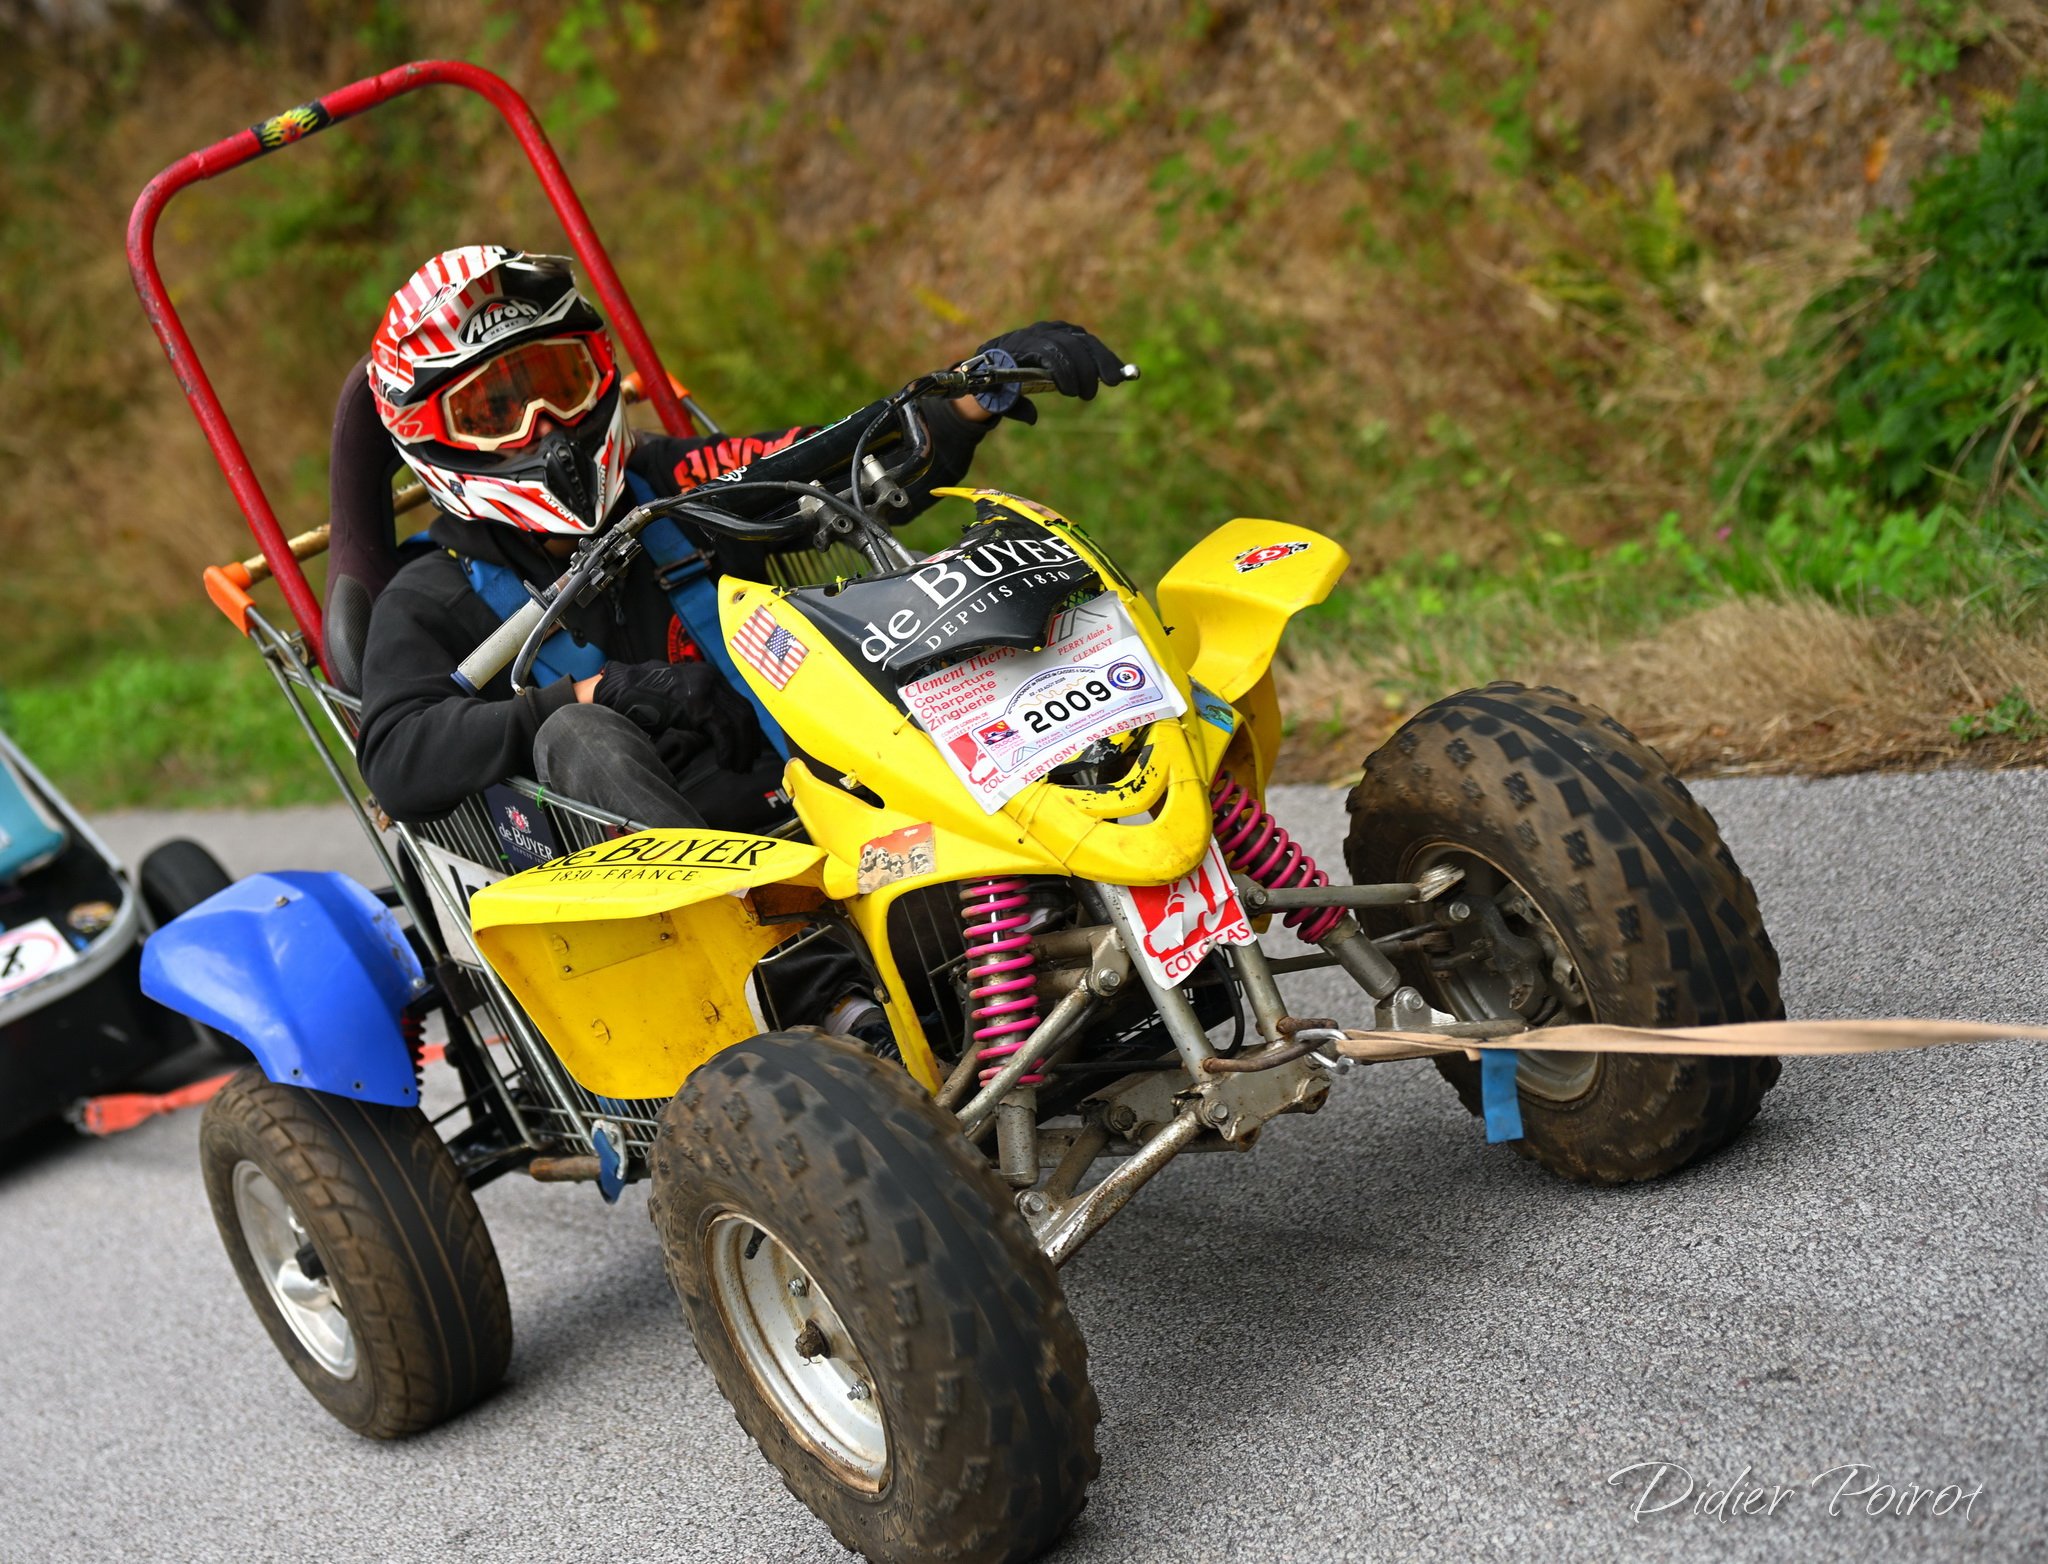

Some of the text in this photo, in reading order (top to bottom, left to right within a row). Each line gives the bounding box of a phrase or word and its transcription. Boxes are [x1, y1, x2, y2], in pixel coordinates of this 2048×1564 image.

[467, 300, 539, 344] Airoh
[540, 493, 576, 522] Airoh
[925, 570, 1071, 650] DEPUIS 1830
[861, 607, 922, 663] de
[1057, 624, 1114, 656] PERRY Alain &
[1072, 638, 1113, 663] CLEMENT
[905, 646, 1016, 698] Clement Therry
[914, 669, 996, 708] Couverture
[921, 680, 997, 719] Charpente
[926, 694, 996, 731] Zinguerie
[1024, 680, 1112, 734] 2009
[1021, 743, 1079, 784] XERTIGNY
[498, 822, 553, 860] de BUYER
[594, 837, 777, 866] BUYER
